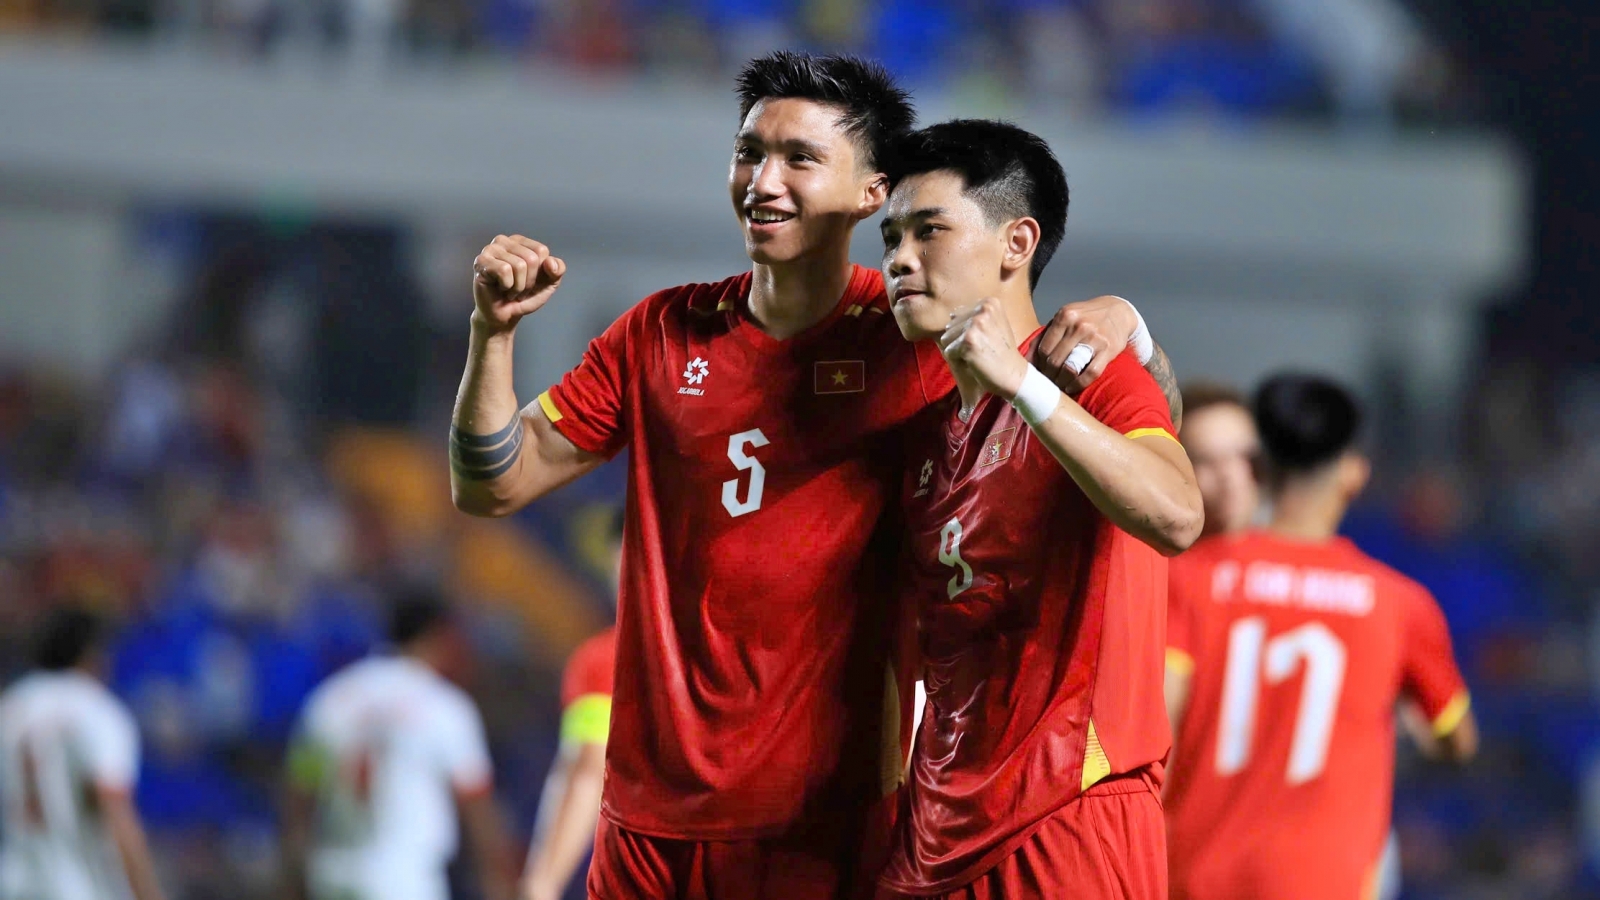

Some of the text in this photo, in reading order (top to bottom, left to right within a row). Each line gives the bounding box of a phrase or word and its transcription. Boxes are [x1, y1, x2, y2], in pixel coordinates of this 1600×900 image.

[721, 427, 771, 518] 5
[938, 516, 973, 601] 9
[1215, 616, 1347, 786] 17
